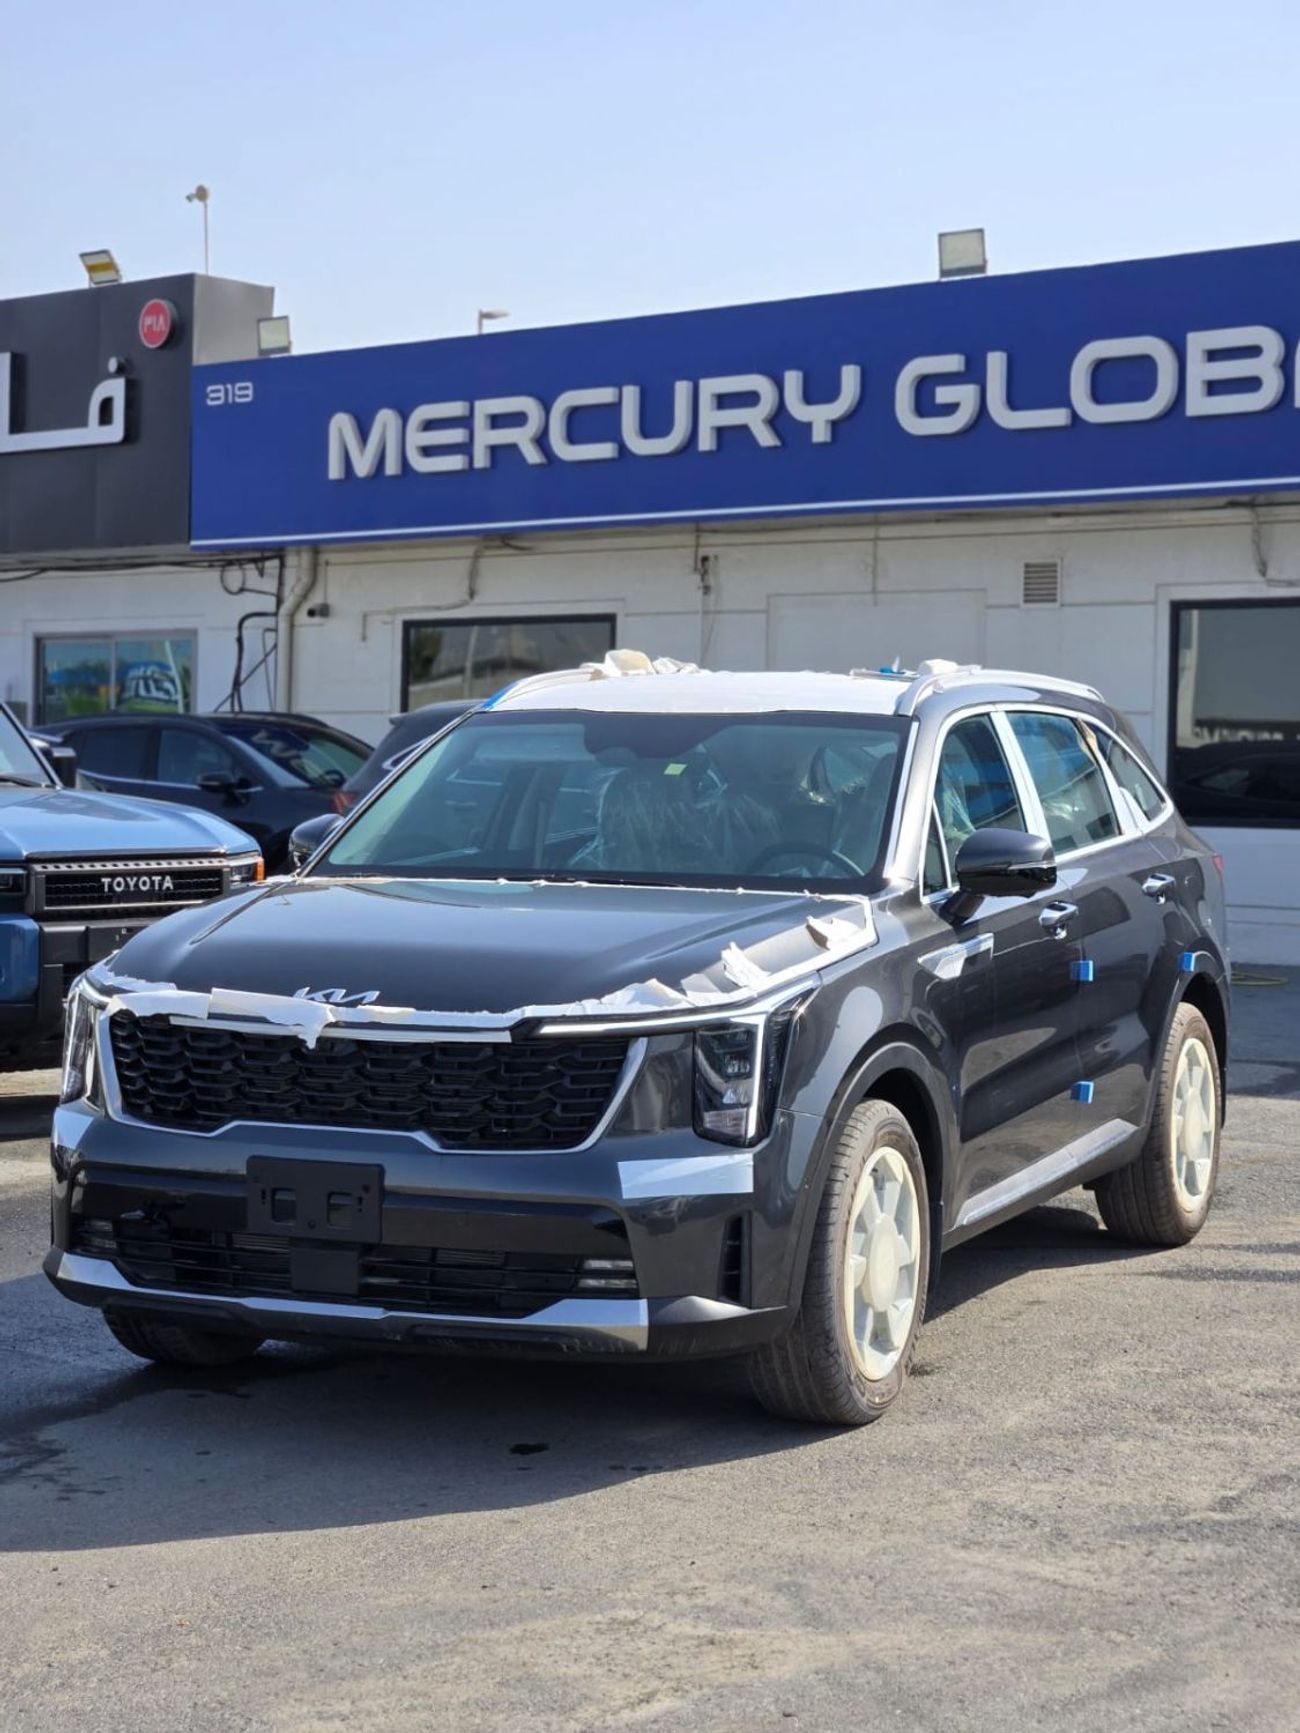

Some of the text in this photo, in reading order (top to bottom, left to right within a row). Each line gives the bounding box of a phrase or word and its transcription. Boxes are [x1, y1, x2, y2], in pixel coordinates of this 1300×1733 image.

[206, 381, 253, 406] 319
[328, 325, 1300, 481] MERCURY GLOB
[101, 875, 174, 893] TOYOTA
